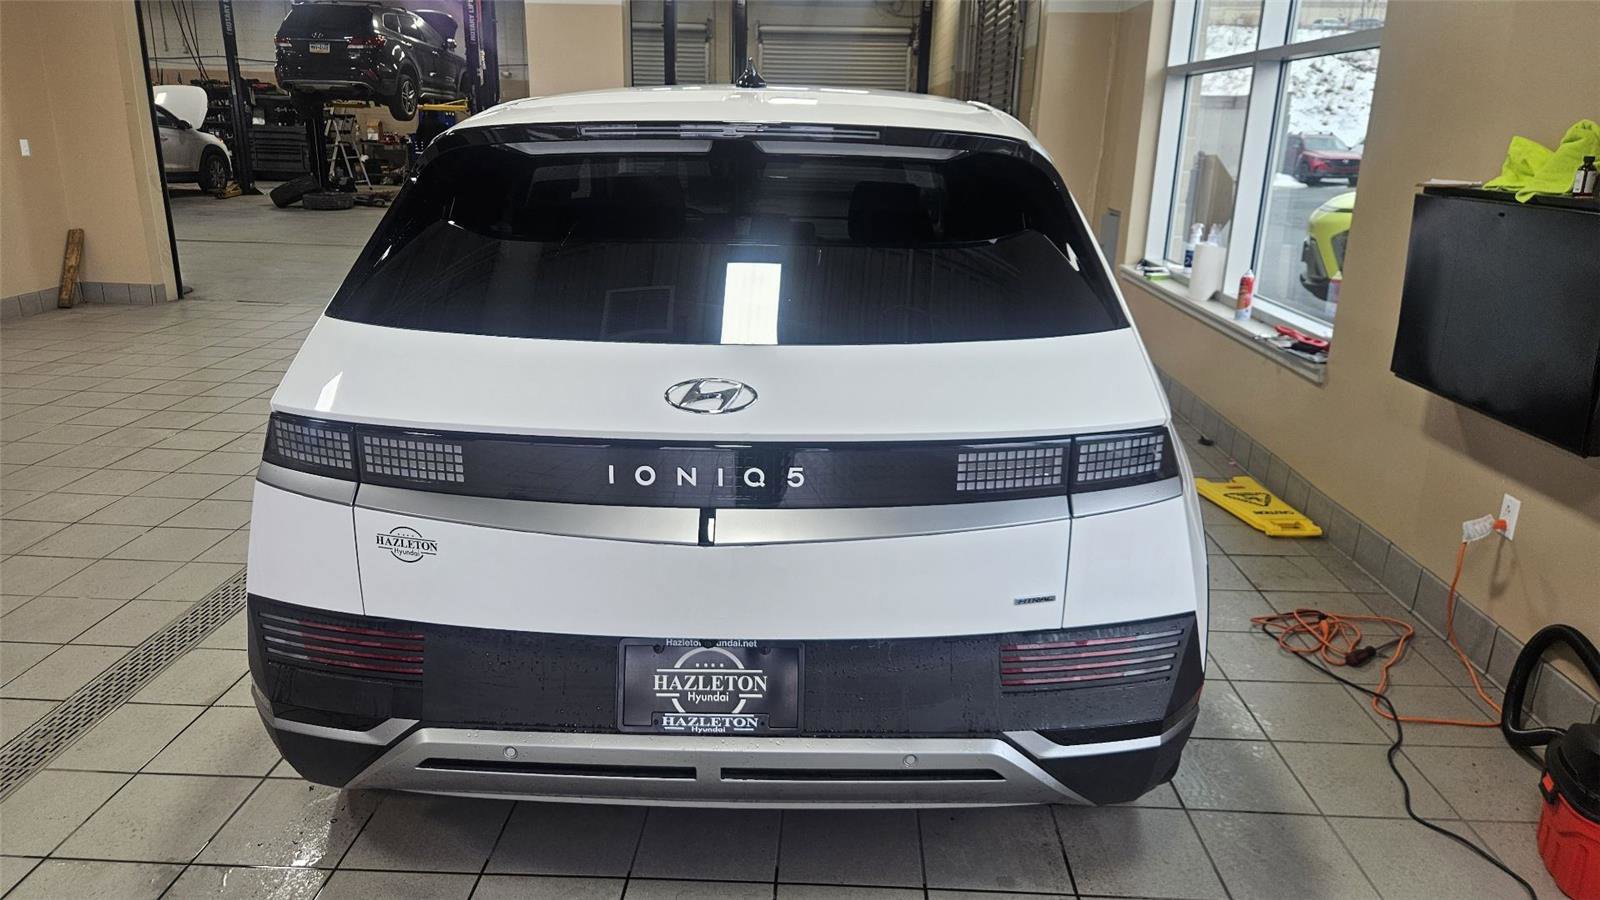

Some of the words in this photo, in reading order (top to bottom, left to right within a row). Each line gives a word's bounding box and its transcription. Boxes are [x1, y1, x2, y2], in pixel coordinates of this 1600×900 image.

[608, 465, 766, 487] IONIQ
[787, 467, 805, 487] 5
[376, 536, 438, 551] HAZLETON
[394, 548, 420, 556] Hyundai
[653, 675, 767, 692] HAZLETON
[687, 692, 729, 704] Hyundai
[662, 717, 759, 728] HAZLETON
